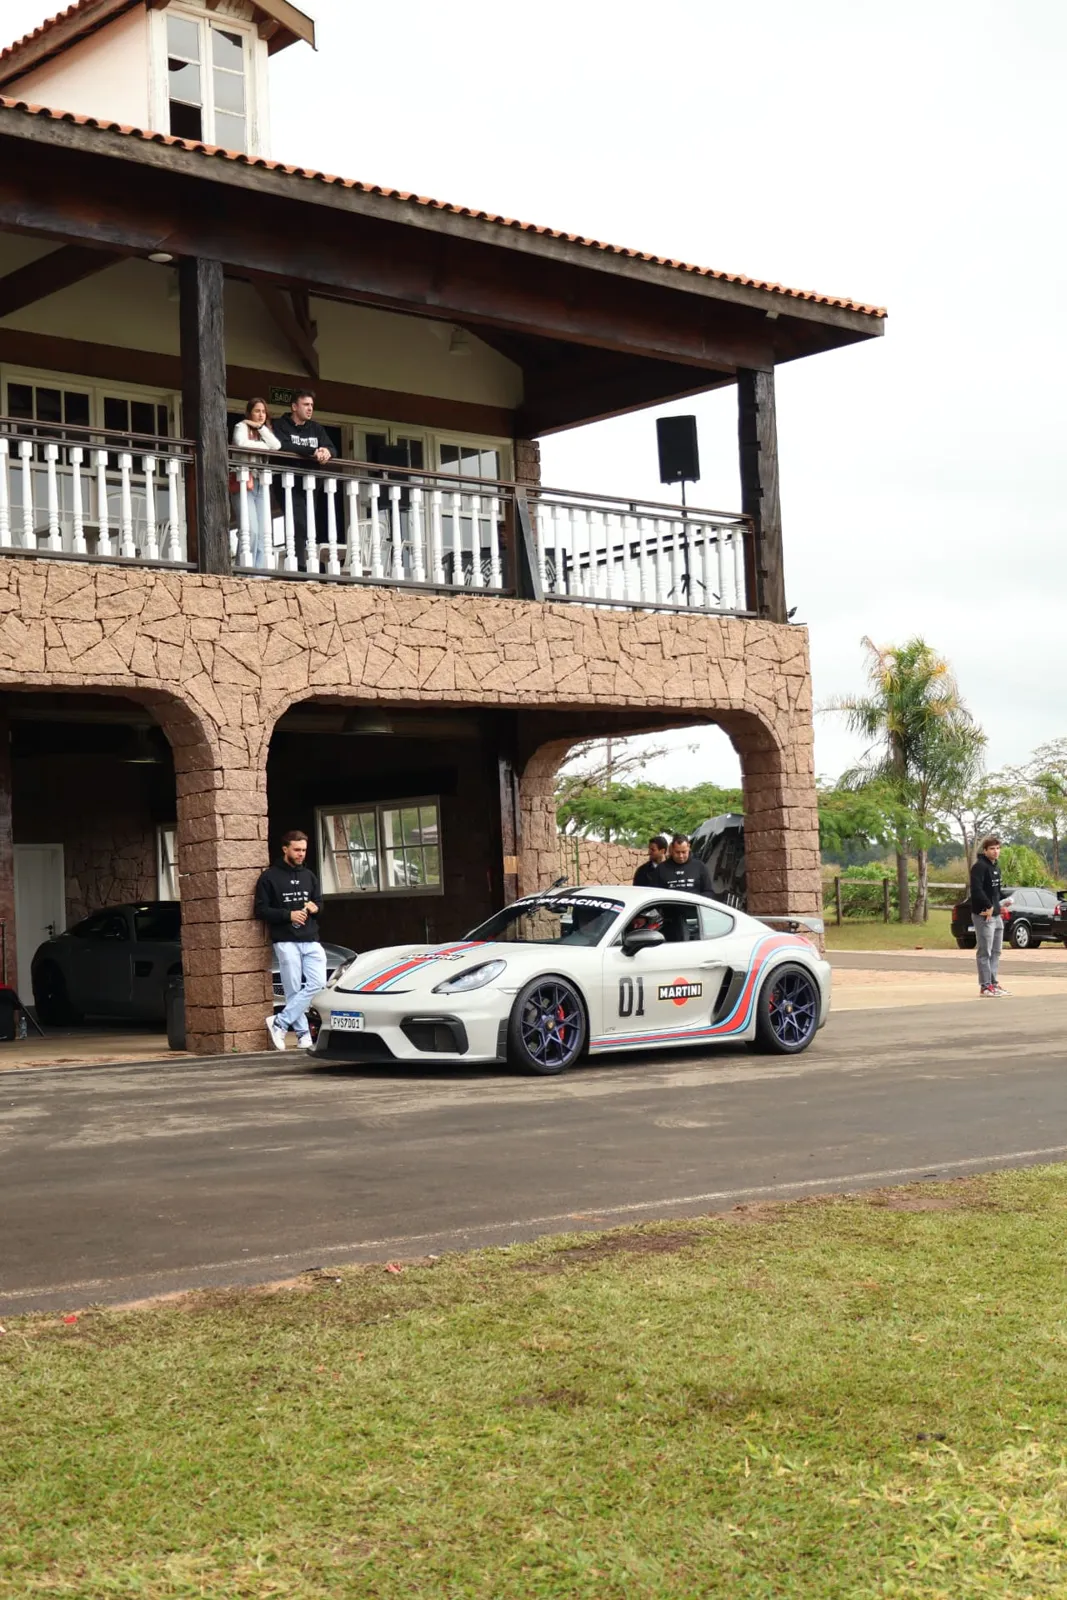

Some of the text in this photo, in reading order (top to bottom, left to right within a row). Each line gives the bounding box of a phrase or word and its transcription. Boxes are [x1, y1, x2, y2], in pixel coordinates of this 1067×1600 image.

[556, 898, 612, 909] RACING
[618, 976, 645, 1017] 01
[659, 985, 701, 999] MARTINI
